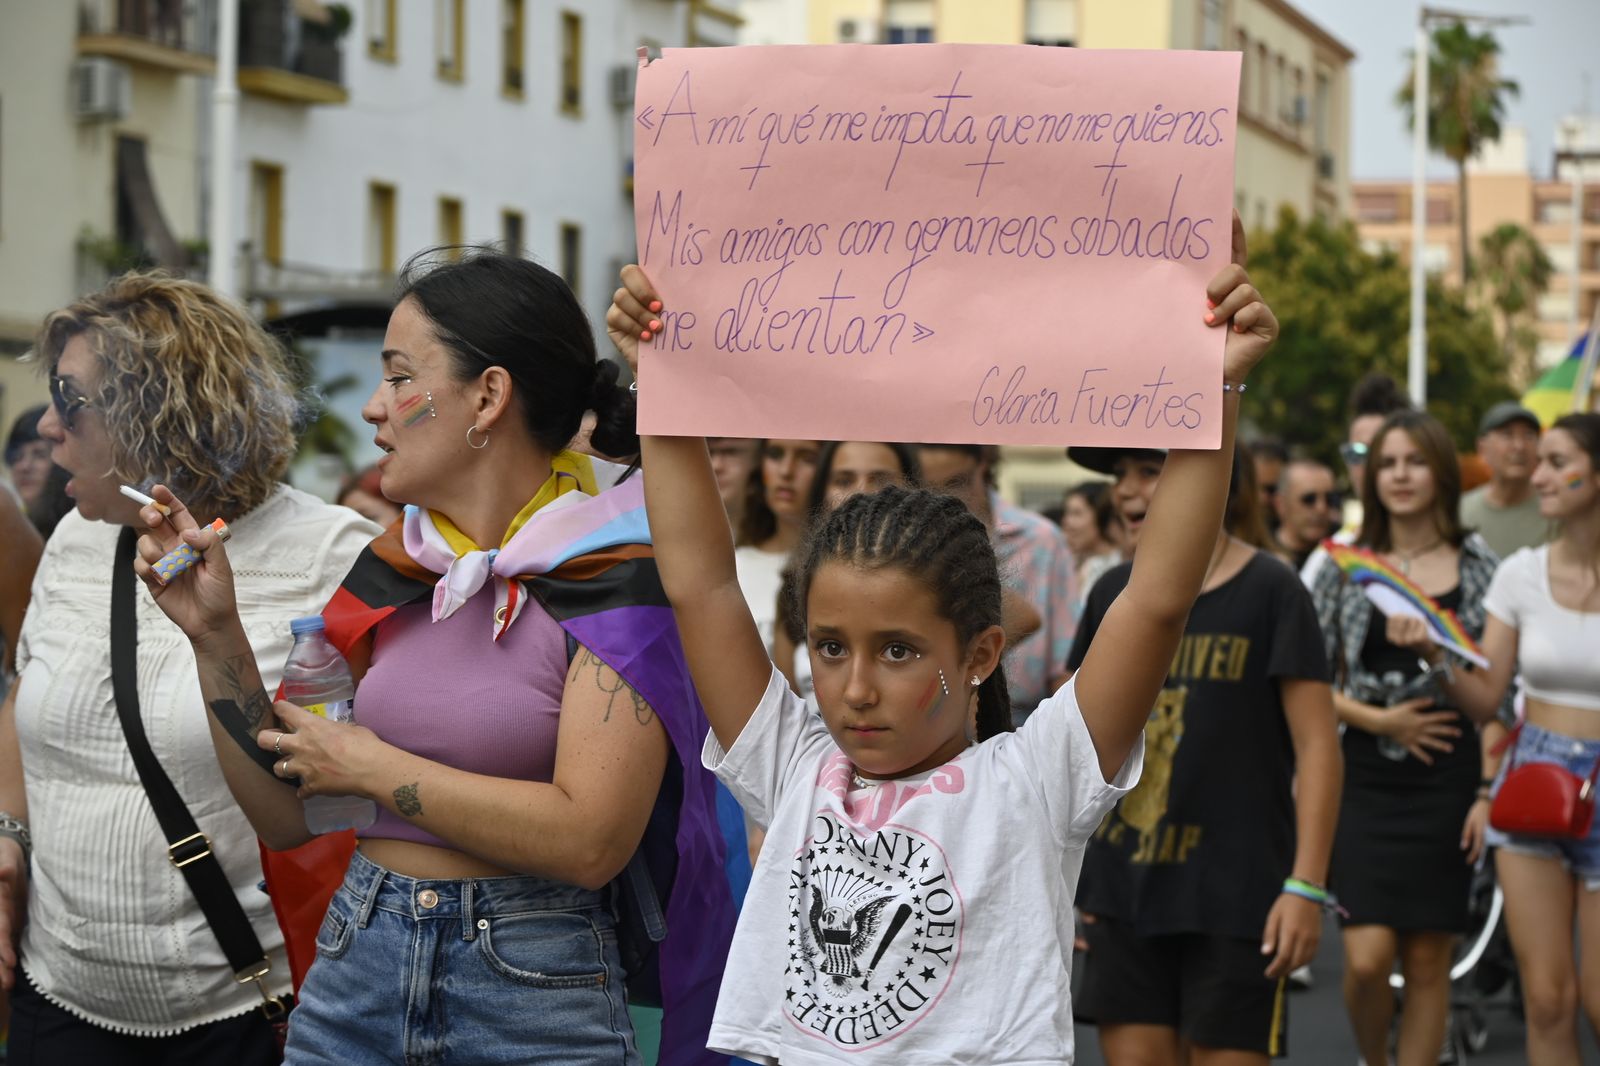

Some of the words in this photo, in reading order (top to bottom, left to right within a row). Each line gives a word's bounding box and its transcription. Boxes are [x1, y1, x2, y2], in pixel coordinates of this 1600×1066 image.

[707, 107, 758, 144] mí
[739, 104, 819, 190] qué
[819, 111, 868, 142] me
[965, 114, 1035, 197] que
[1036, 112, 1073, 143] no
[1072, 112, 1112, 142] me
[1093, 104, 1229, 196] quieras.
[643, 190, 710, 267] Mis
[719, 218, 829, 306] amigos
[838, 219, 905, 255] con
[1063, 174, 1214, 260] sobados
[653, 310, 697, 352] me
[973, 365, 1060, 427] Gloria
[1070, 366, 1204, 429] Fuertes
[918, 869, 956, 966] JOEY
